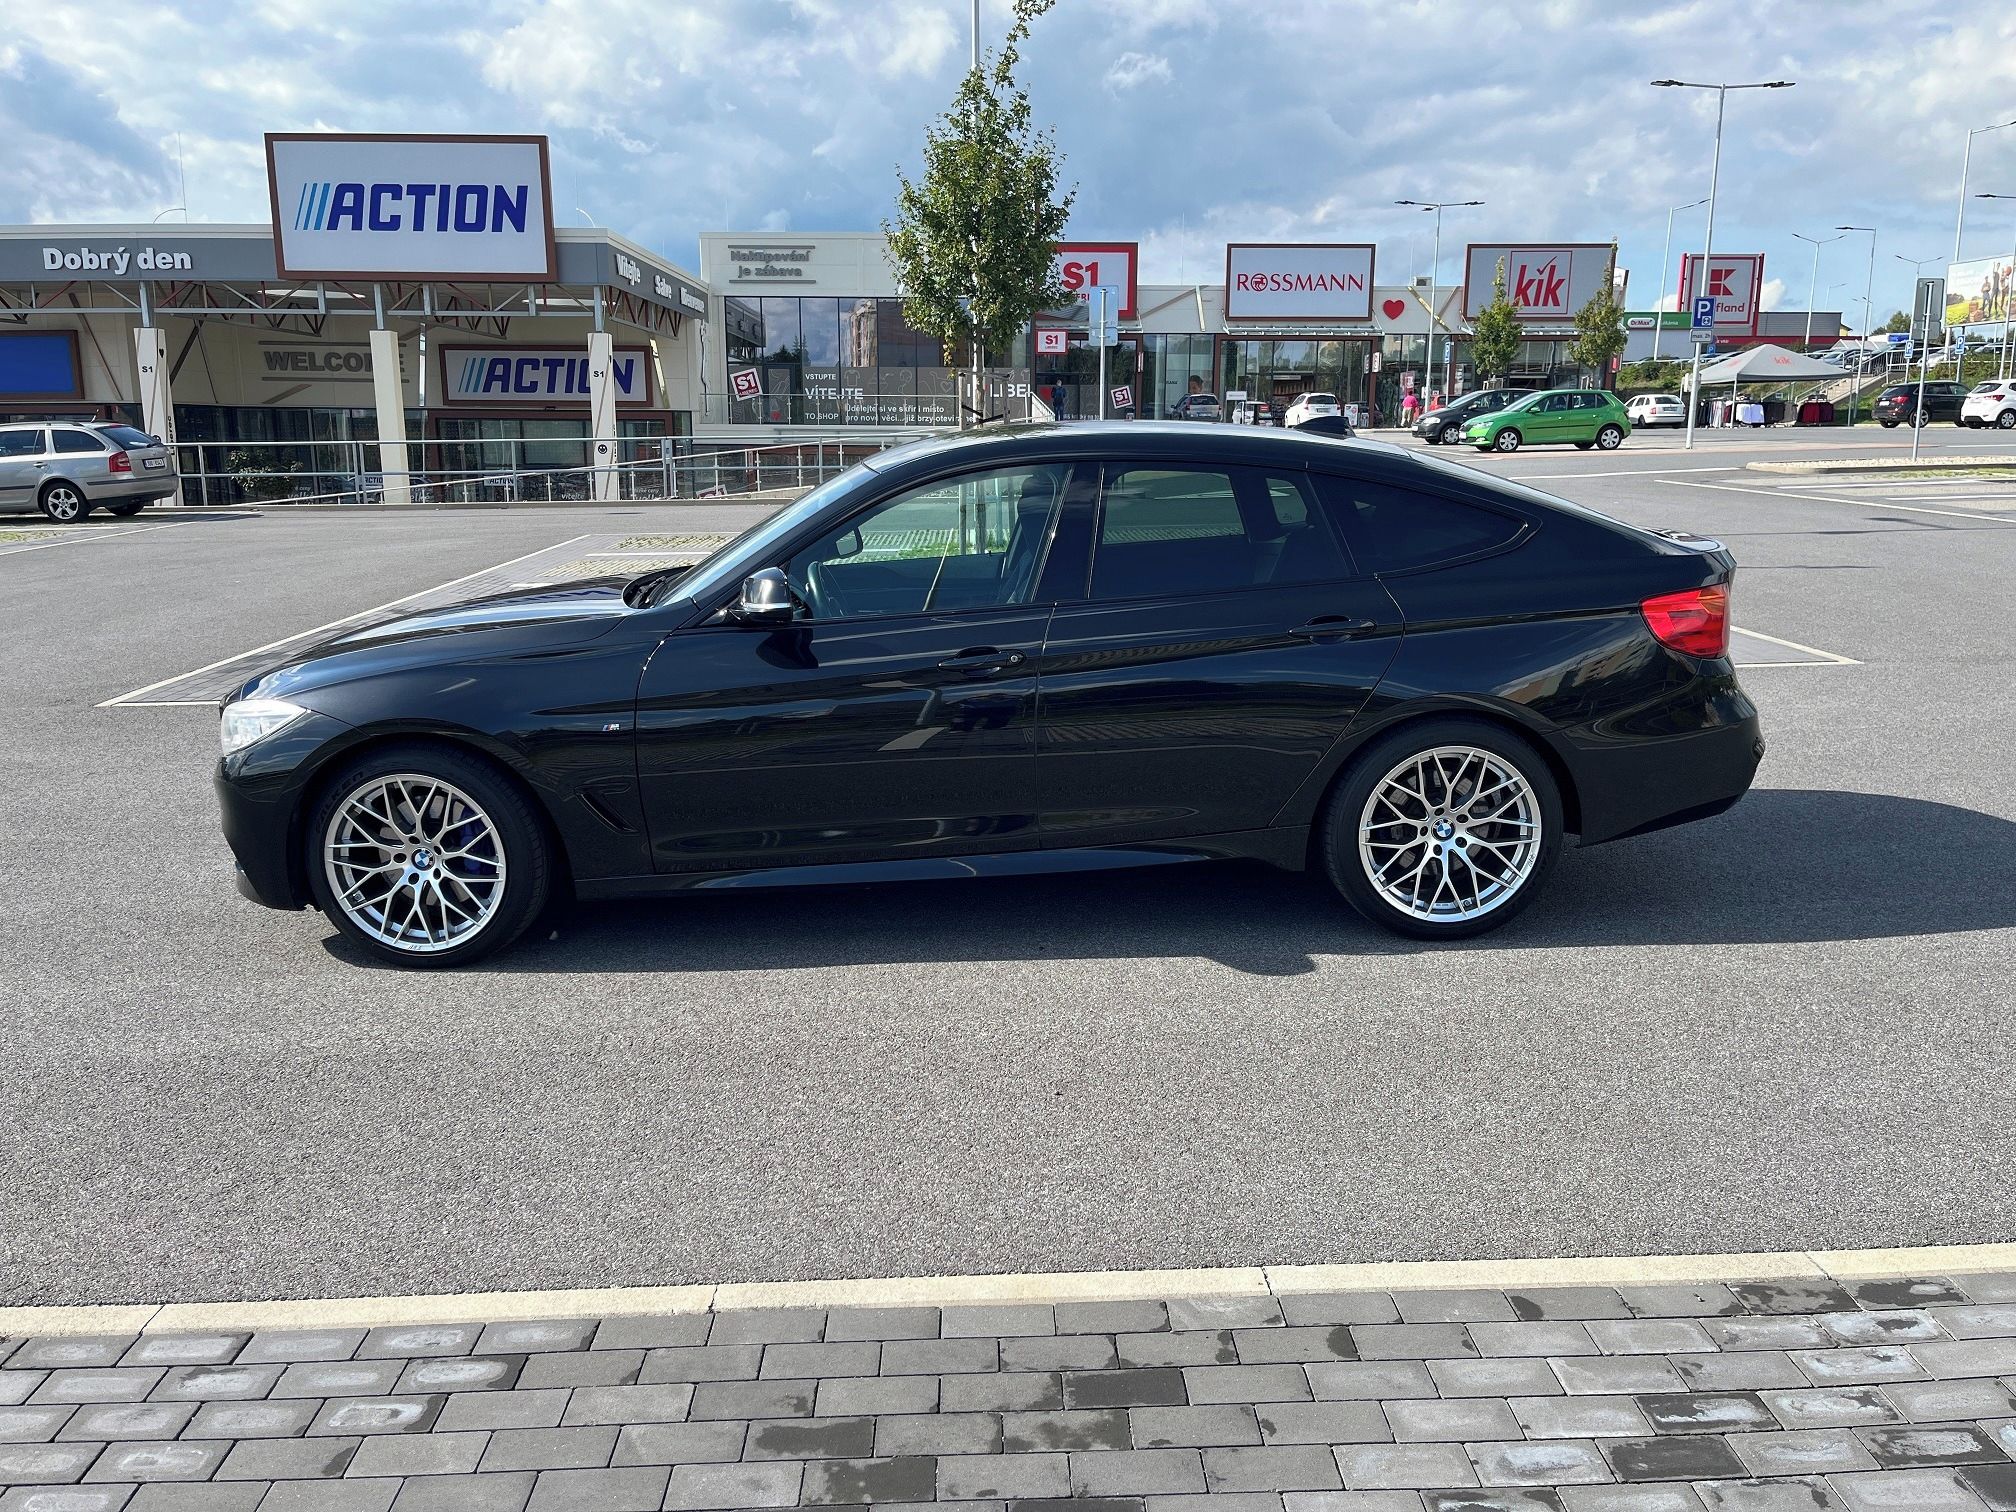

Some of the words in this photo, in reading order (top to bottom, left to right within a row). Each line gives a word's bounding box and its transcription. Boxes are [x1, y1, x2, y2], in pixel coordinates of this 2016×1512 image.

[326, 182, 529, 233] ACTION
[42, 246, 131, 275] Dobrý
[136, 247, 192, 270] den
[738, 265, 752, 279] je
[754, 264, 803, 277] zábava
[1061, 261, 1099, 290] S1
[1236, 272, 1364, 293] ROSSMANN
[1697, 300, 1711, 319] P
[1715, 302, 1745, 313] fland
[1045, 334, 1059, 345] S1
[141, 365, 154, 373] S1
[263, 351, 406, 373] WELCO
[593, 370, 605, 378] S1
[736, 373, 756, 391] S1
[804, 384, 864, 401] VÍTEJTE
[1114, 389, 1128, 402] S1
[804, 412, 816, 420] TO
[817, 412, 839, 420] SHOP
[364, 476, 384, 484] CTIO
